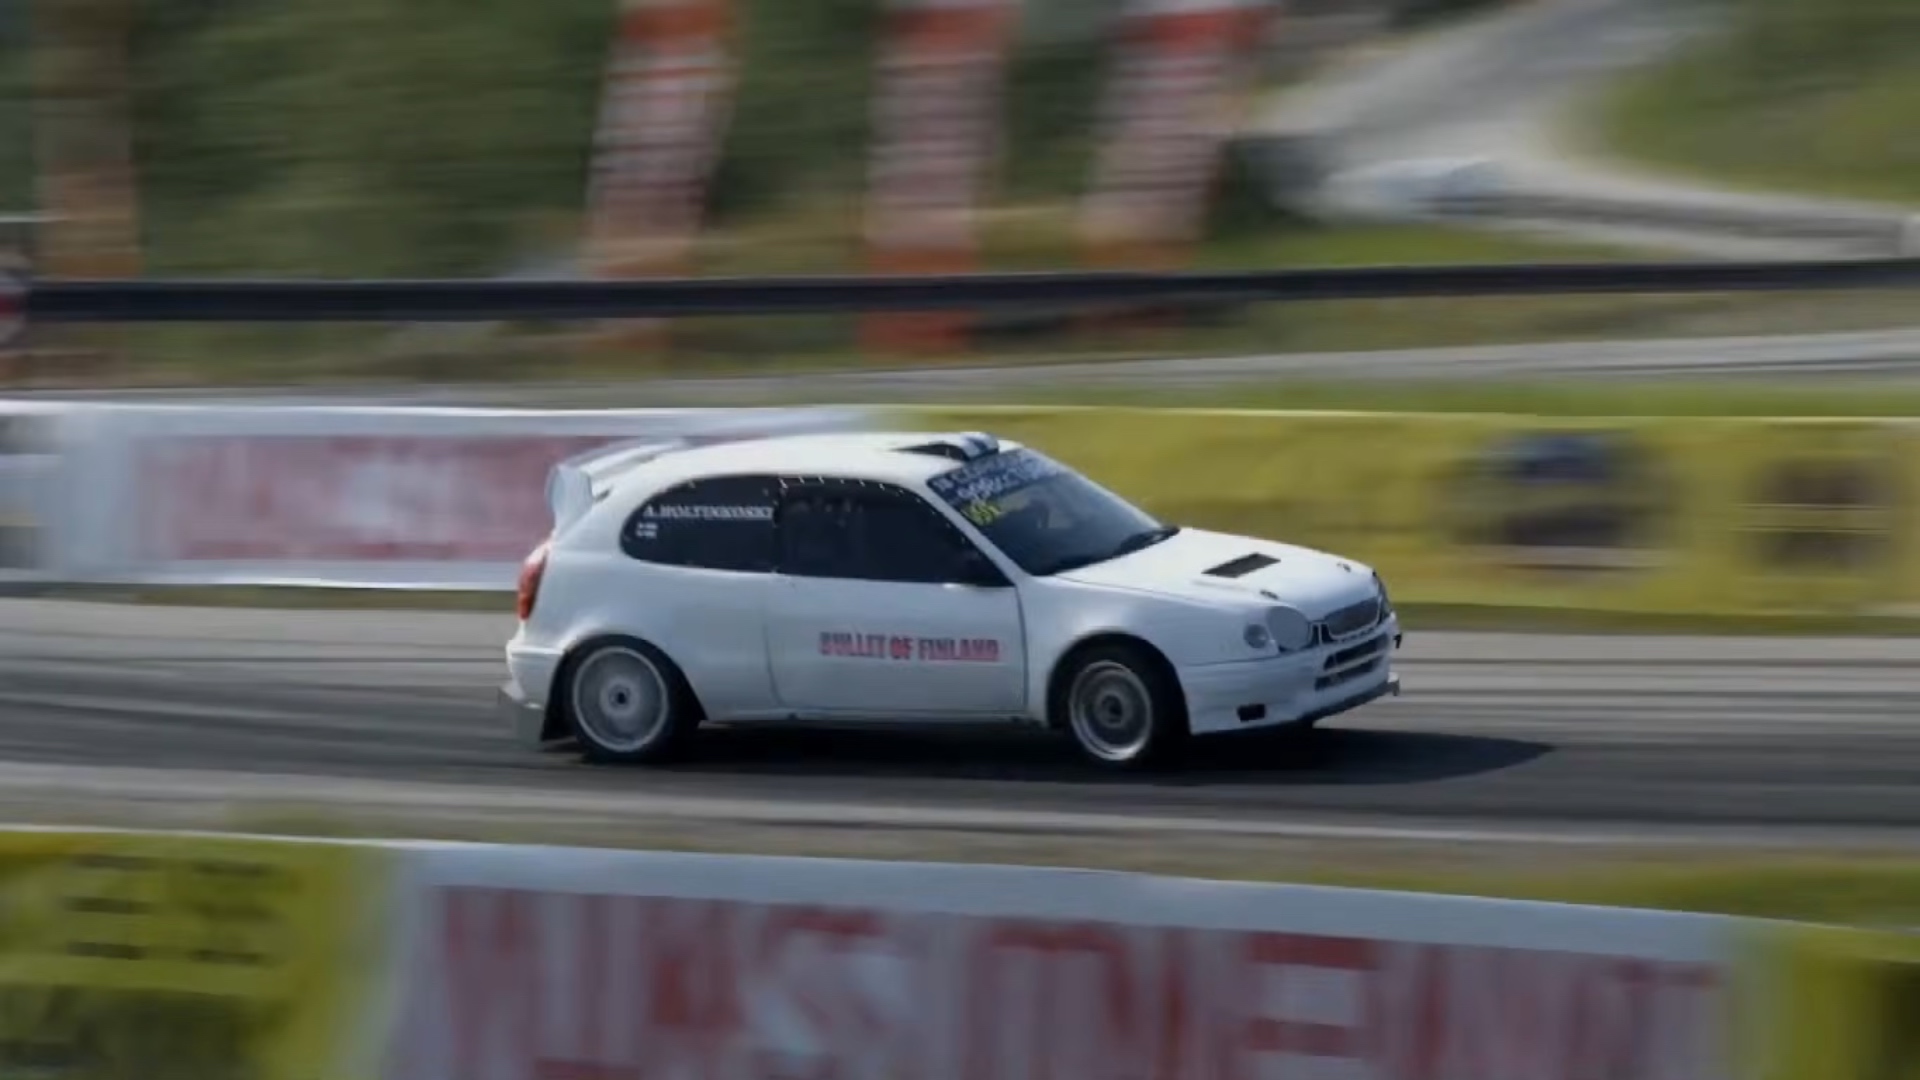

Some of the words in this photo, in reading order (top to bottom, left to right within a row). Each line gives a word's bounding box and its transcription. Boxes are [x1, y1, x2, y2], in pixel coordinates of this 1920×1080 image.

[819, 630, 887, 660] BULLET
[890, 634, 913, 661] OF
[918, 637, 1000, 663] FINLAND
